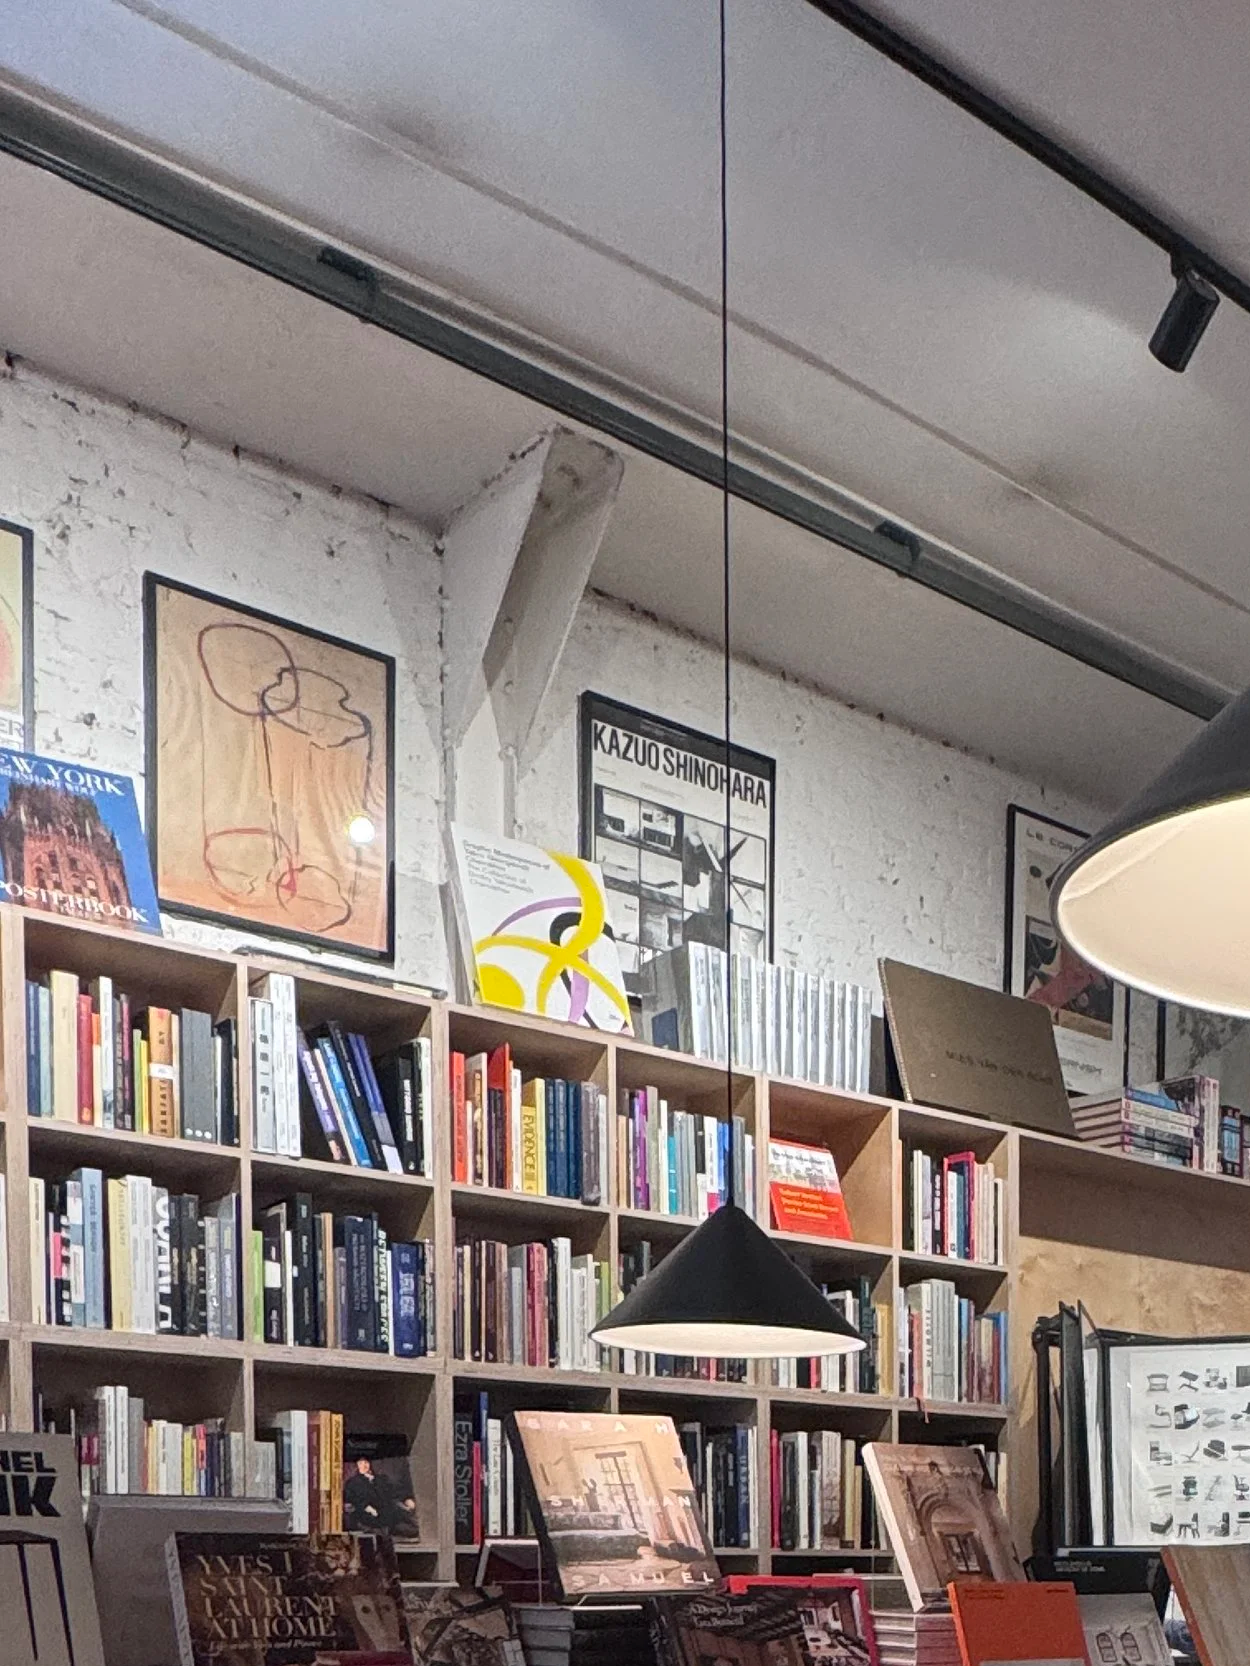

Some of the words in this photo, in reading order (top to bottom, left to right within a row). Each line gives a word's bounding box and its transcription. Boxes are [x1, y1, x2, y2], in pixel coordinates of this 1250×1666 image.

[593, 722, 660, 771] KAZUO
[663, 747, 767, 808] SHINOHARA
[46, 764, 125, 796] YORK
[522, 1114, 536, 1171] EVIDENCE
[455, 1420, 473, 1462] Ezra
[454, 1464, 473, 1526] Stoller
[197, 1555, 273, 1576] YVES
[572, 1572, 715, 1587] SAMUEL
[200, 1576, 287, 1597] SAINT
[204, 1595, 340, 1618] LAURENT
[207, 1617, 245, 1640] AT
[250, 1616, 338, 1639] HOME
